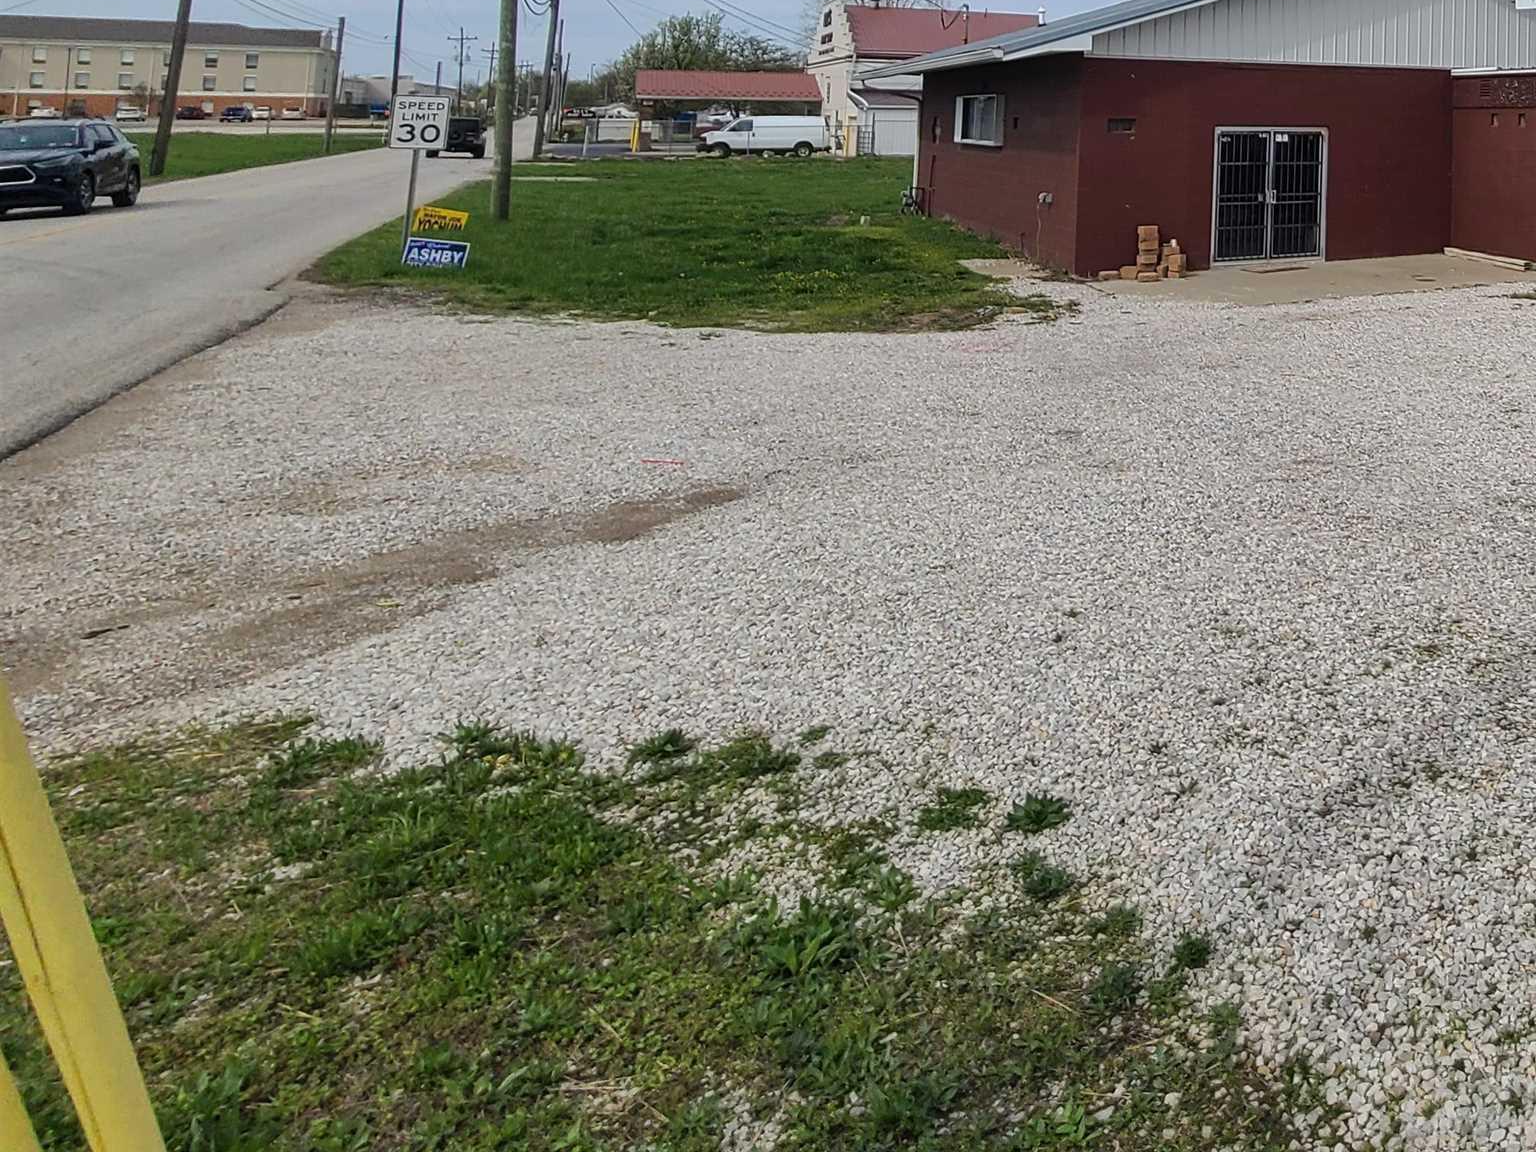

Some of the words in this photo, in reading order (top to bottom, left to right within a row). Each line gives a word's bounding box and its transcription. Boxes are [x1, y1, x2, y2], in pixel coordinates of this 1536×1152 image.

[398, 100, 446, 111] SPEED
[402, 112, 439, 122] LIMIT
[396, 123, 441, 144] 30
[408, 247, 464, 263] ASHBY
